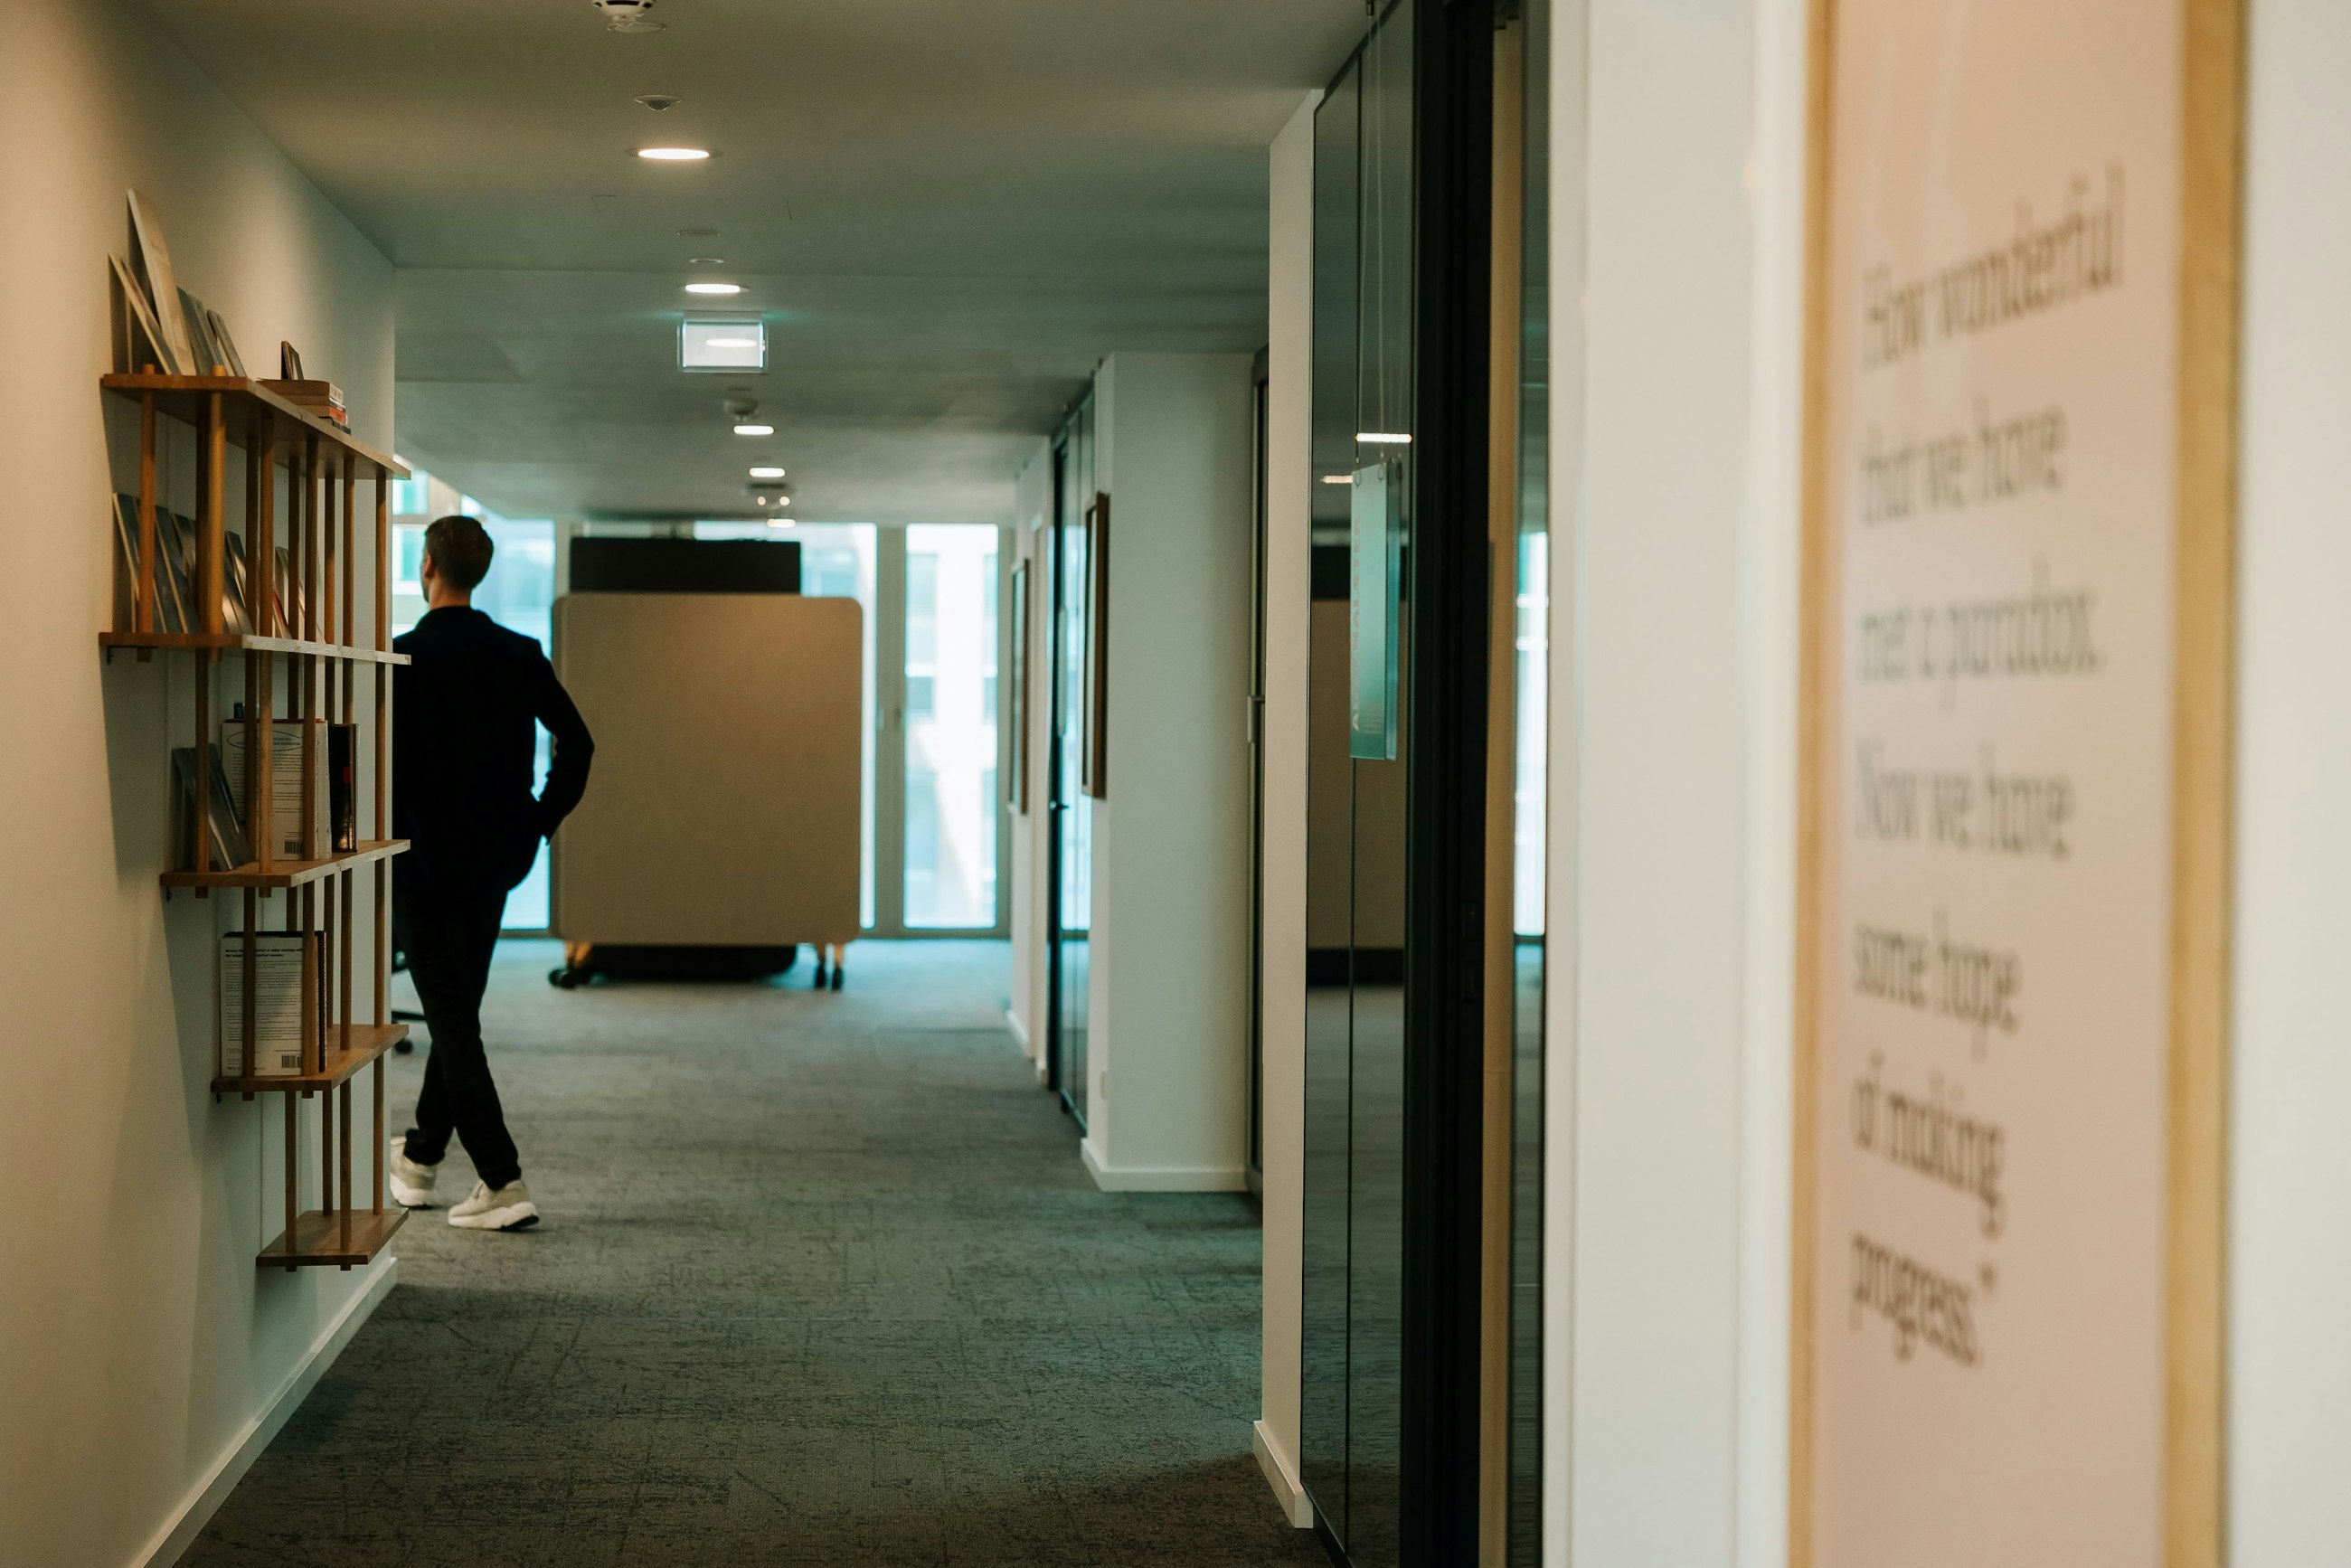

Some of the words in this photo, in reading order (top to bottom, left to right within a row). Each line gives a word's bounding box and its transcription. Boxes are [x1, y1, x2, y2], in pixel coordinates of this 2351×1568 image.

[1933, 156, 2126, 338] wonderful
[1972, 393, 2069, 499] have
[1978, 738, 2075, 863] have
[1932, 903, 2023, 1063] hope
[1884, 1067, 2006, 1241] making
